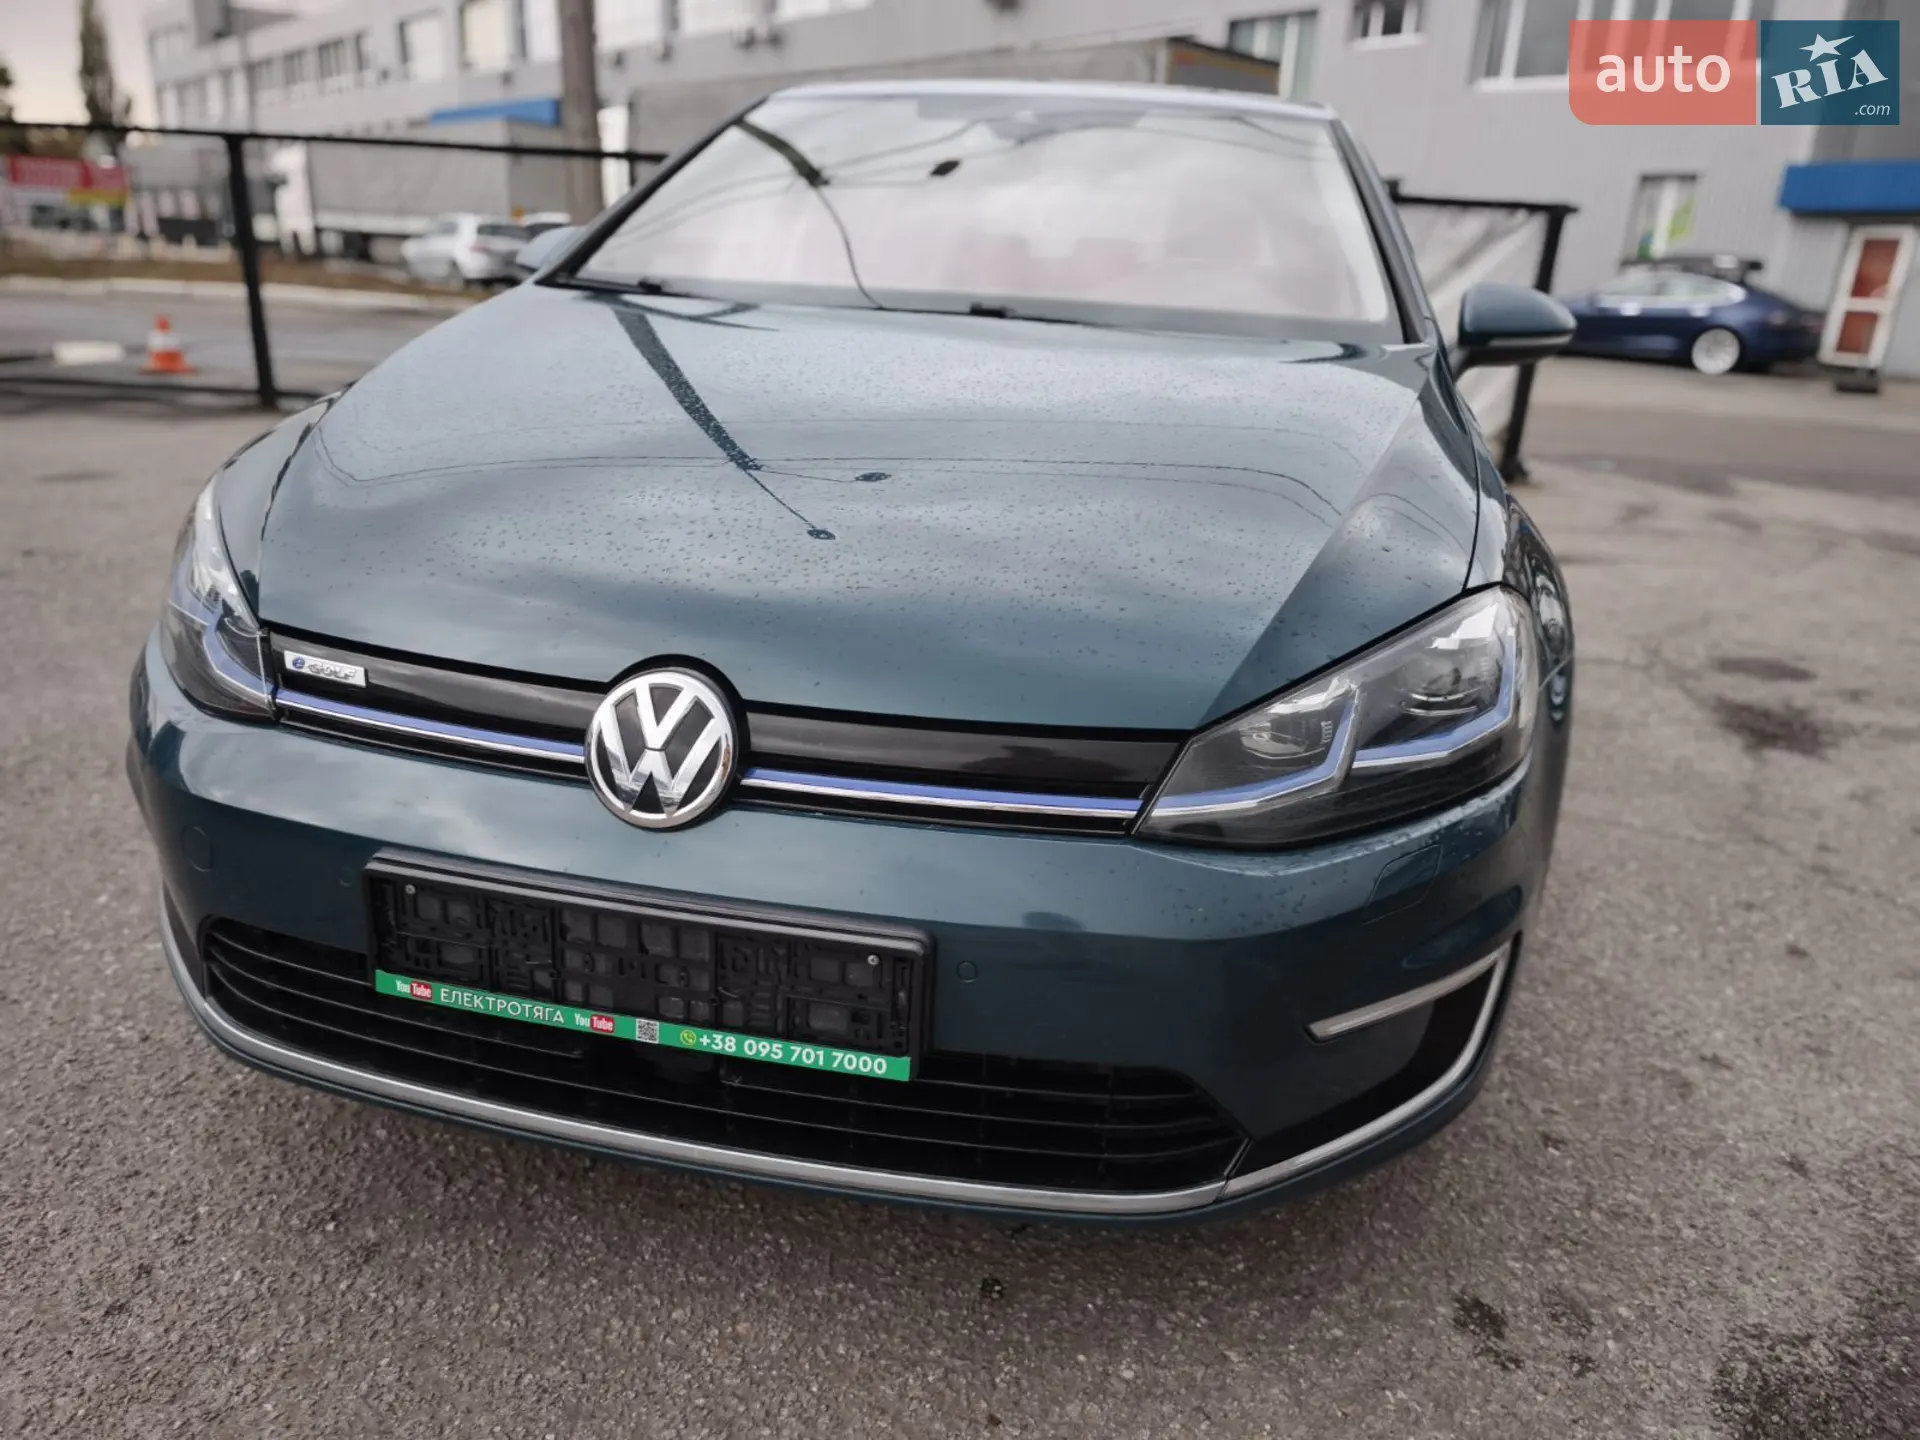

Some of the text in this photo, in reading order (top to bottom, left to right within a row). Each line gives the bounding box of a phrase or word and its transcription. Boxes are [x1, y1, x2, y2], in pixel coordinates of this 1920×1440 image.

[440, 988, 565, 1024] ЕЛЕКТРОТЯГА
[699, 1034, 887, 1075] +38 095 701 7000
